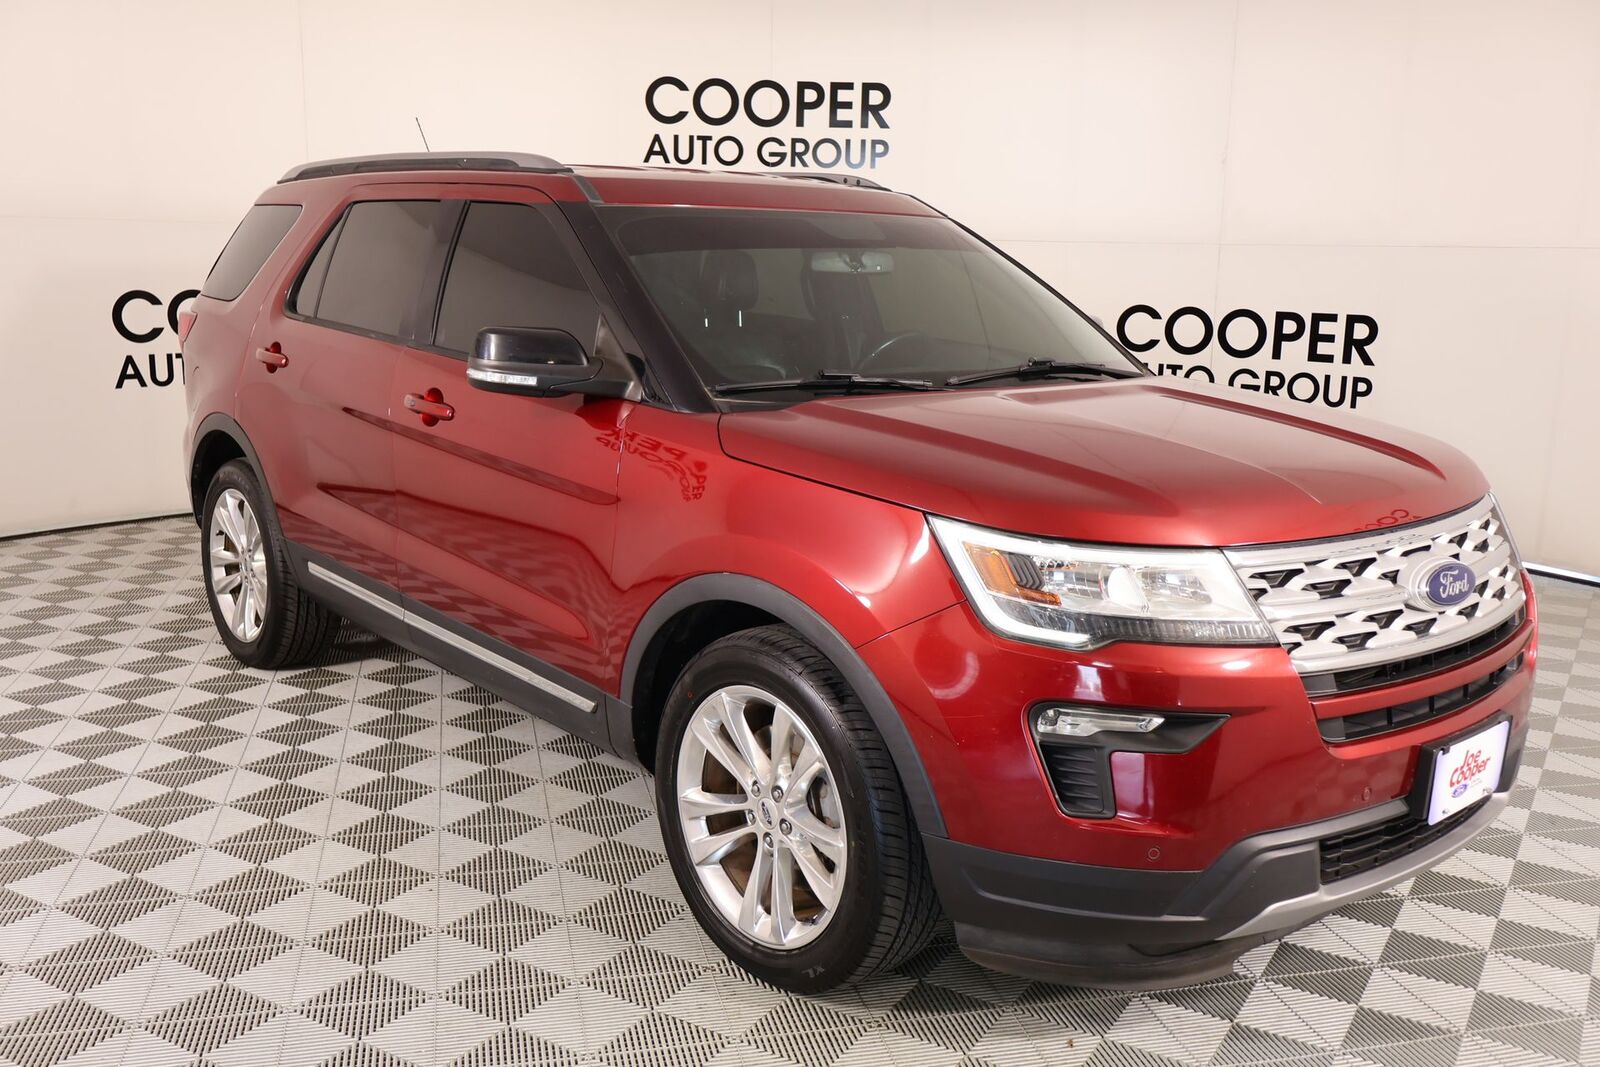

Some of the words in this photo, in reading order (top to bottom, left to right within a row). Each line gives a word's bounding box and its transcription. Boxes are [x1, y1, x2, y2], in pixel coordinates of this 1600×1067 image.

[645, 76, 892, 129] COOPER
[643, 134, 744, 166] AUTO
[757, 137, 890, 170] GROUP
[1116, 304, 1379, 366] COOPER
[115, 353, 185, 389] AU
[1440, 569, 1469, 599] Ford
[1450, 756, 1491, 788] Cooper
[1460, 750, 1481, 771] Joe
